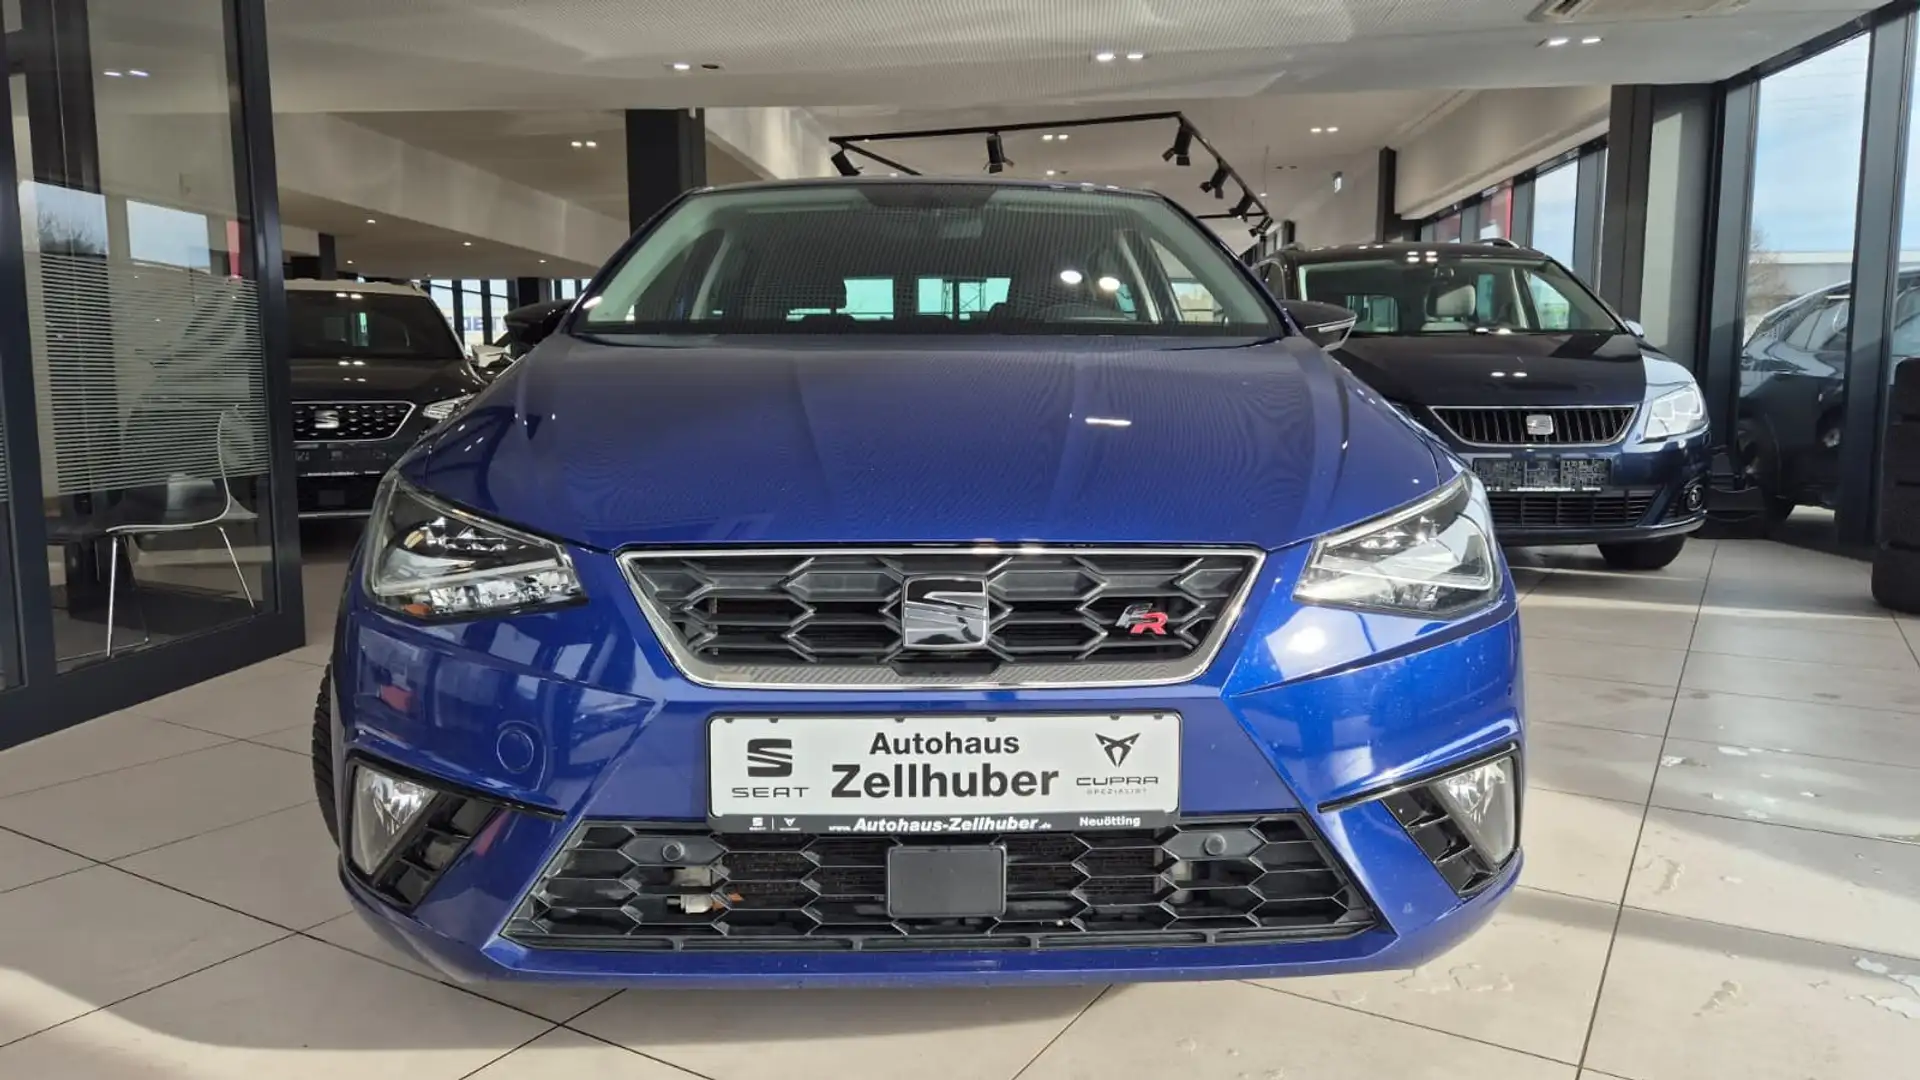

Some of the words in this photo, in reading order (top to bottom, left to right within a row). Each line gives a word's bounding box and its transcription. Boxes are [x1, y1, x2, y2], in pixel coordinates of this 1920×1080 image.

[1115, 602, 1168, 635] FR
[869, 731, 1020, 755] Autohaus
[831, 762, 1059, 798] Zellhuber
[1076, 776, 1159, 786] CUPRA
[731, 787, 809, 798] SEAT
[1079, 815, 1141, 827] Neuötting
